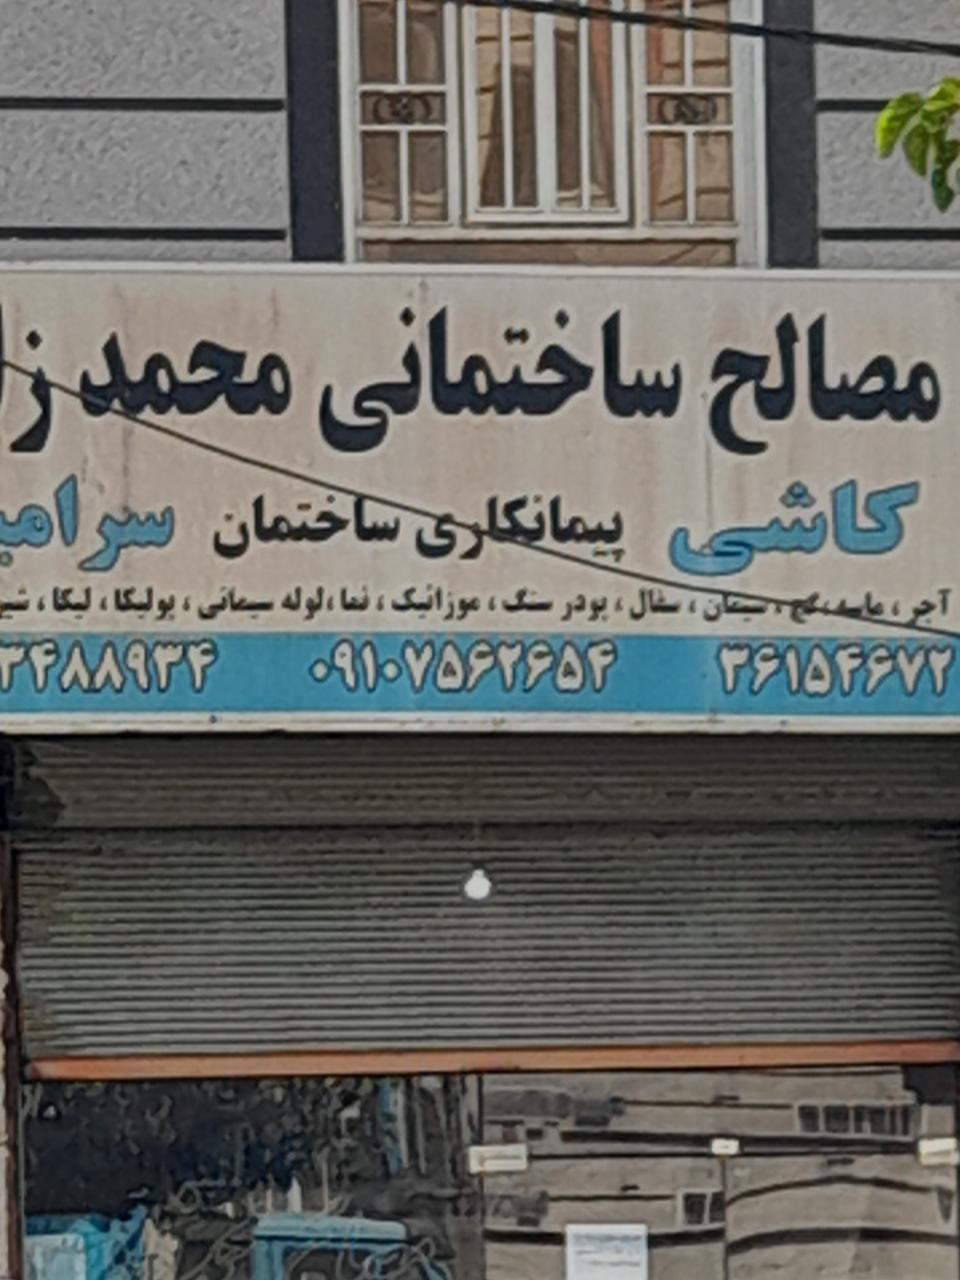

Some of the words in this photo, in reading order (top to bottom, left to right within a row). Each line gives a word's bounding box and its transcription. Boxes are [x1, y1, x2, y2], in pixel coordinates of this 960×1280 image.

[319, 306, 683, 454] ساختمانی
[708, 312, 941, 456] مصالح
[213, 493, 401, 560] ساختمان
[414, 494, 625, 562] پیمانکاری
[668, 478, 920, 577] کاشی
[308, 637, 619, 695] ۰۹۱۰۷۵۶۲۶۵۴
[716, 640, 956, 697] ۳۶۱۵۴۶۷۲
